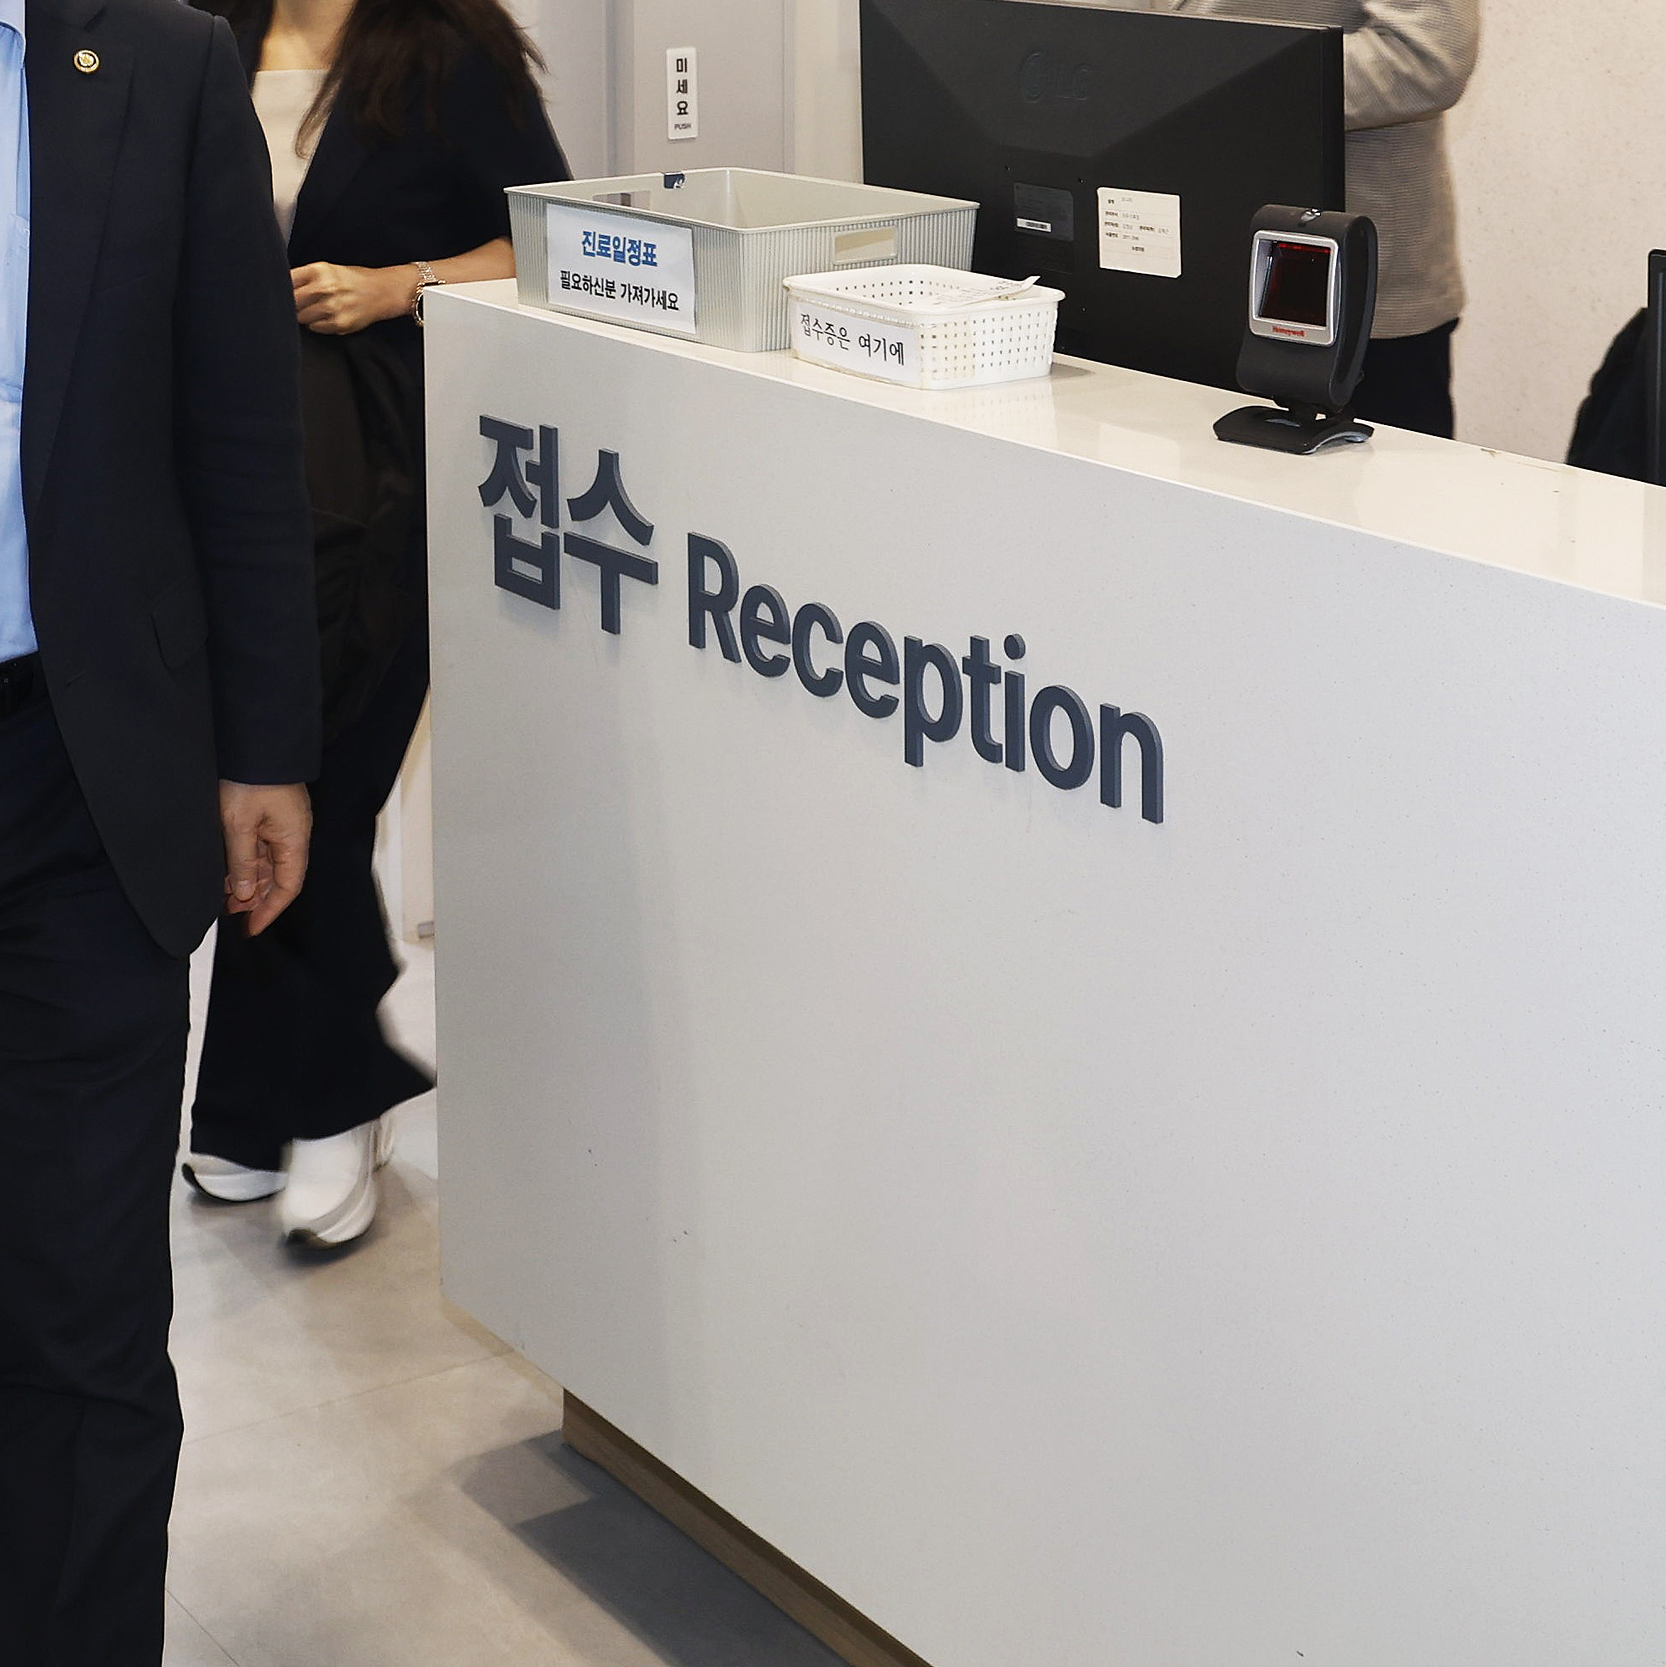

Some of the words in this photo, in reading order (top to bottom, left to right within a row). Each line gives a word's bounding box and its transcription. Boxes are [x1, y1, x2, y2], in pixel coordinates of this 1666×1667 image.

[676, 57, 689, 116] 미세요
[582, 230, 658, 268] 진료일정표
[560, 270, 617, 300] 필요하신분
[619, 282, 680, 312] 가져가세요
[800, 313, 851, 351] 접수증은
[858, 333, 906, 366] 여기에
[478, 414, 658, 635] 접수
[687, 531, 1164, 823] Reception
